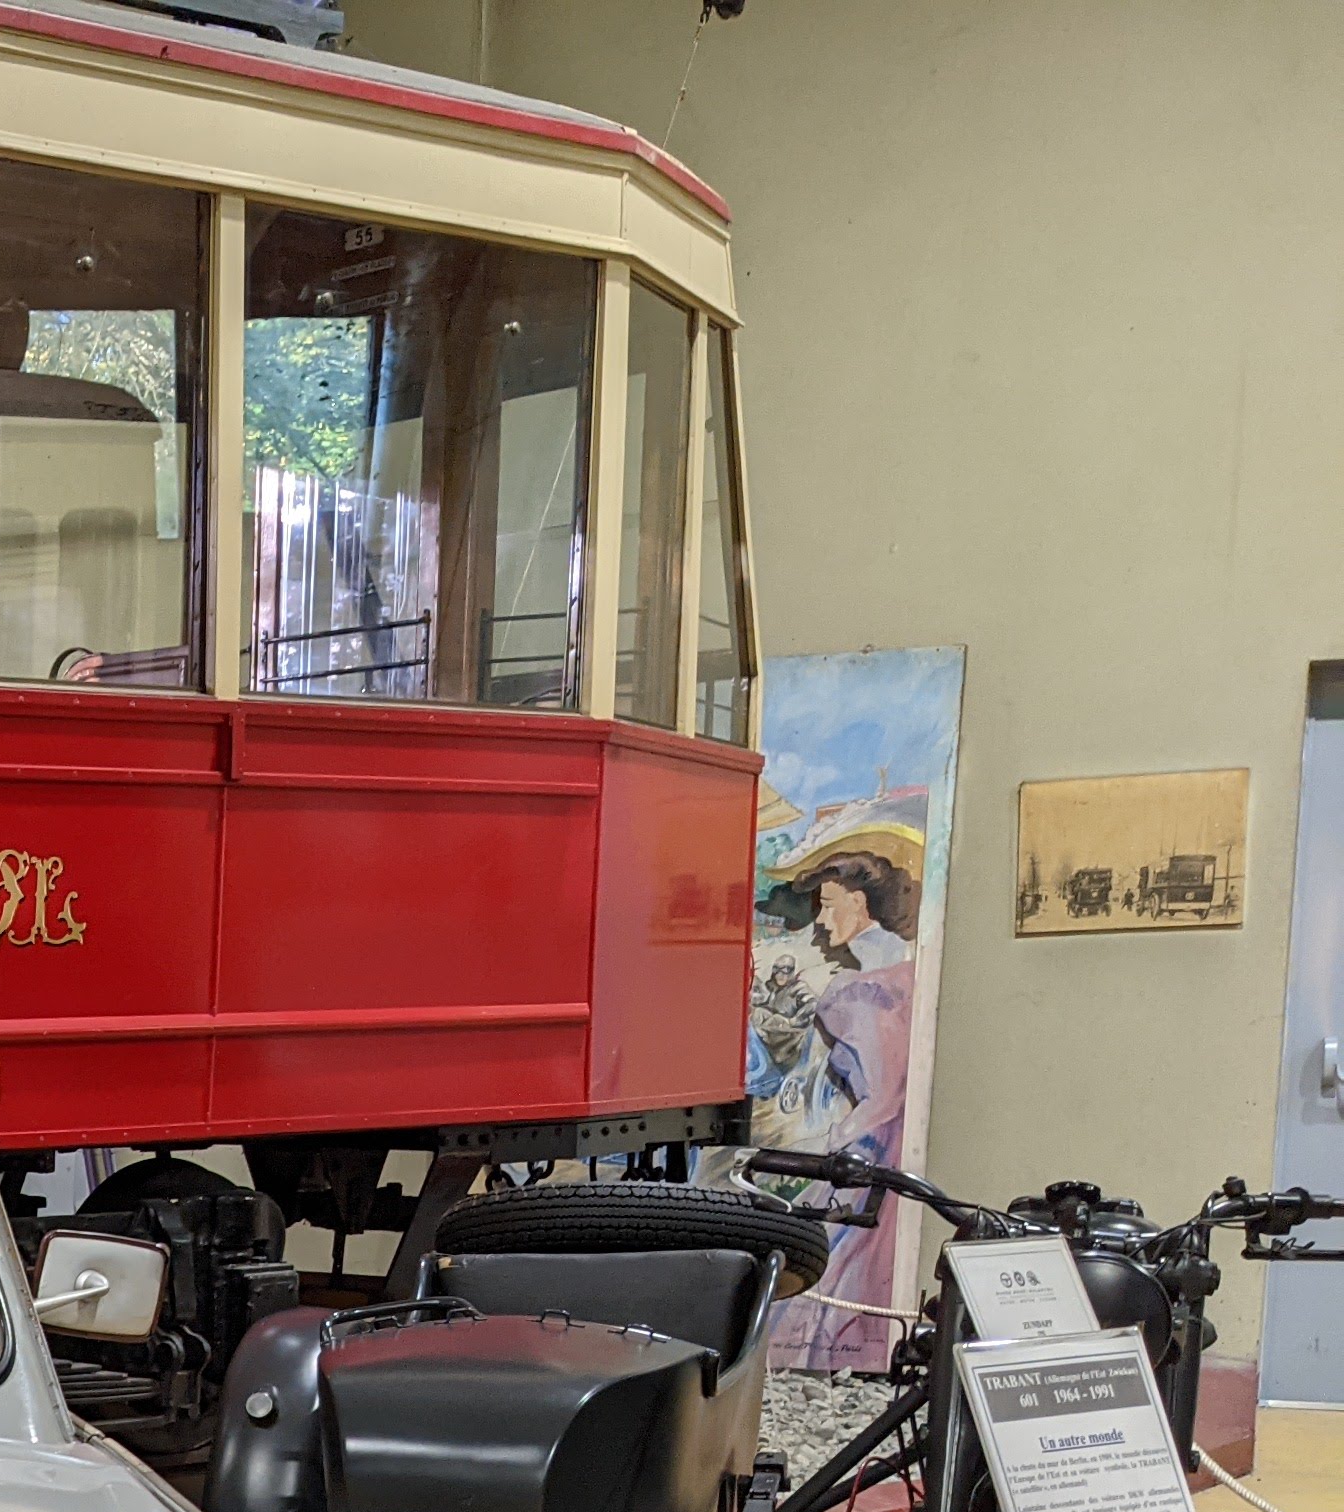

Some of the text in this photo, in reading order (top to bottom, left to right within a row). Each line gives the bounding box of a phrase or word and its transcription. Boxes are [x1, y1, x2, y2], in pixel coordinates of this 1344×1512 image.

[983, 1372, 1041, 1390] TRABANT
[1020, 1392, 1039, 1408] 601
[1040, 1428, 1123, 1449] Un autre monde
